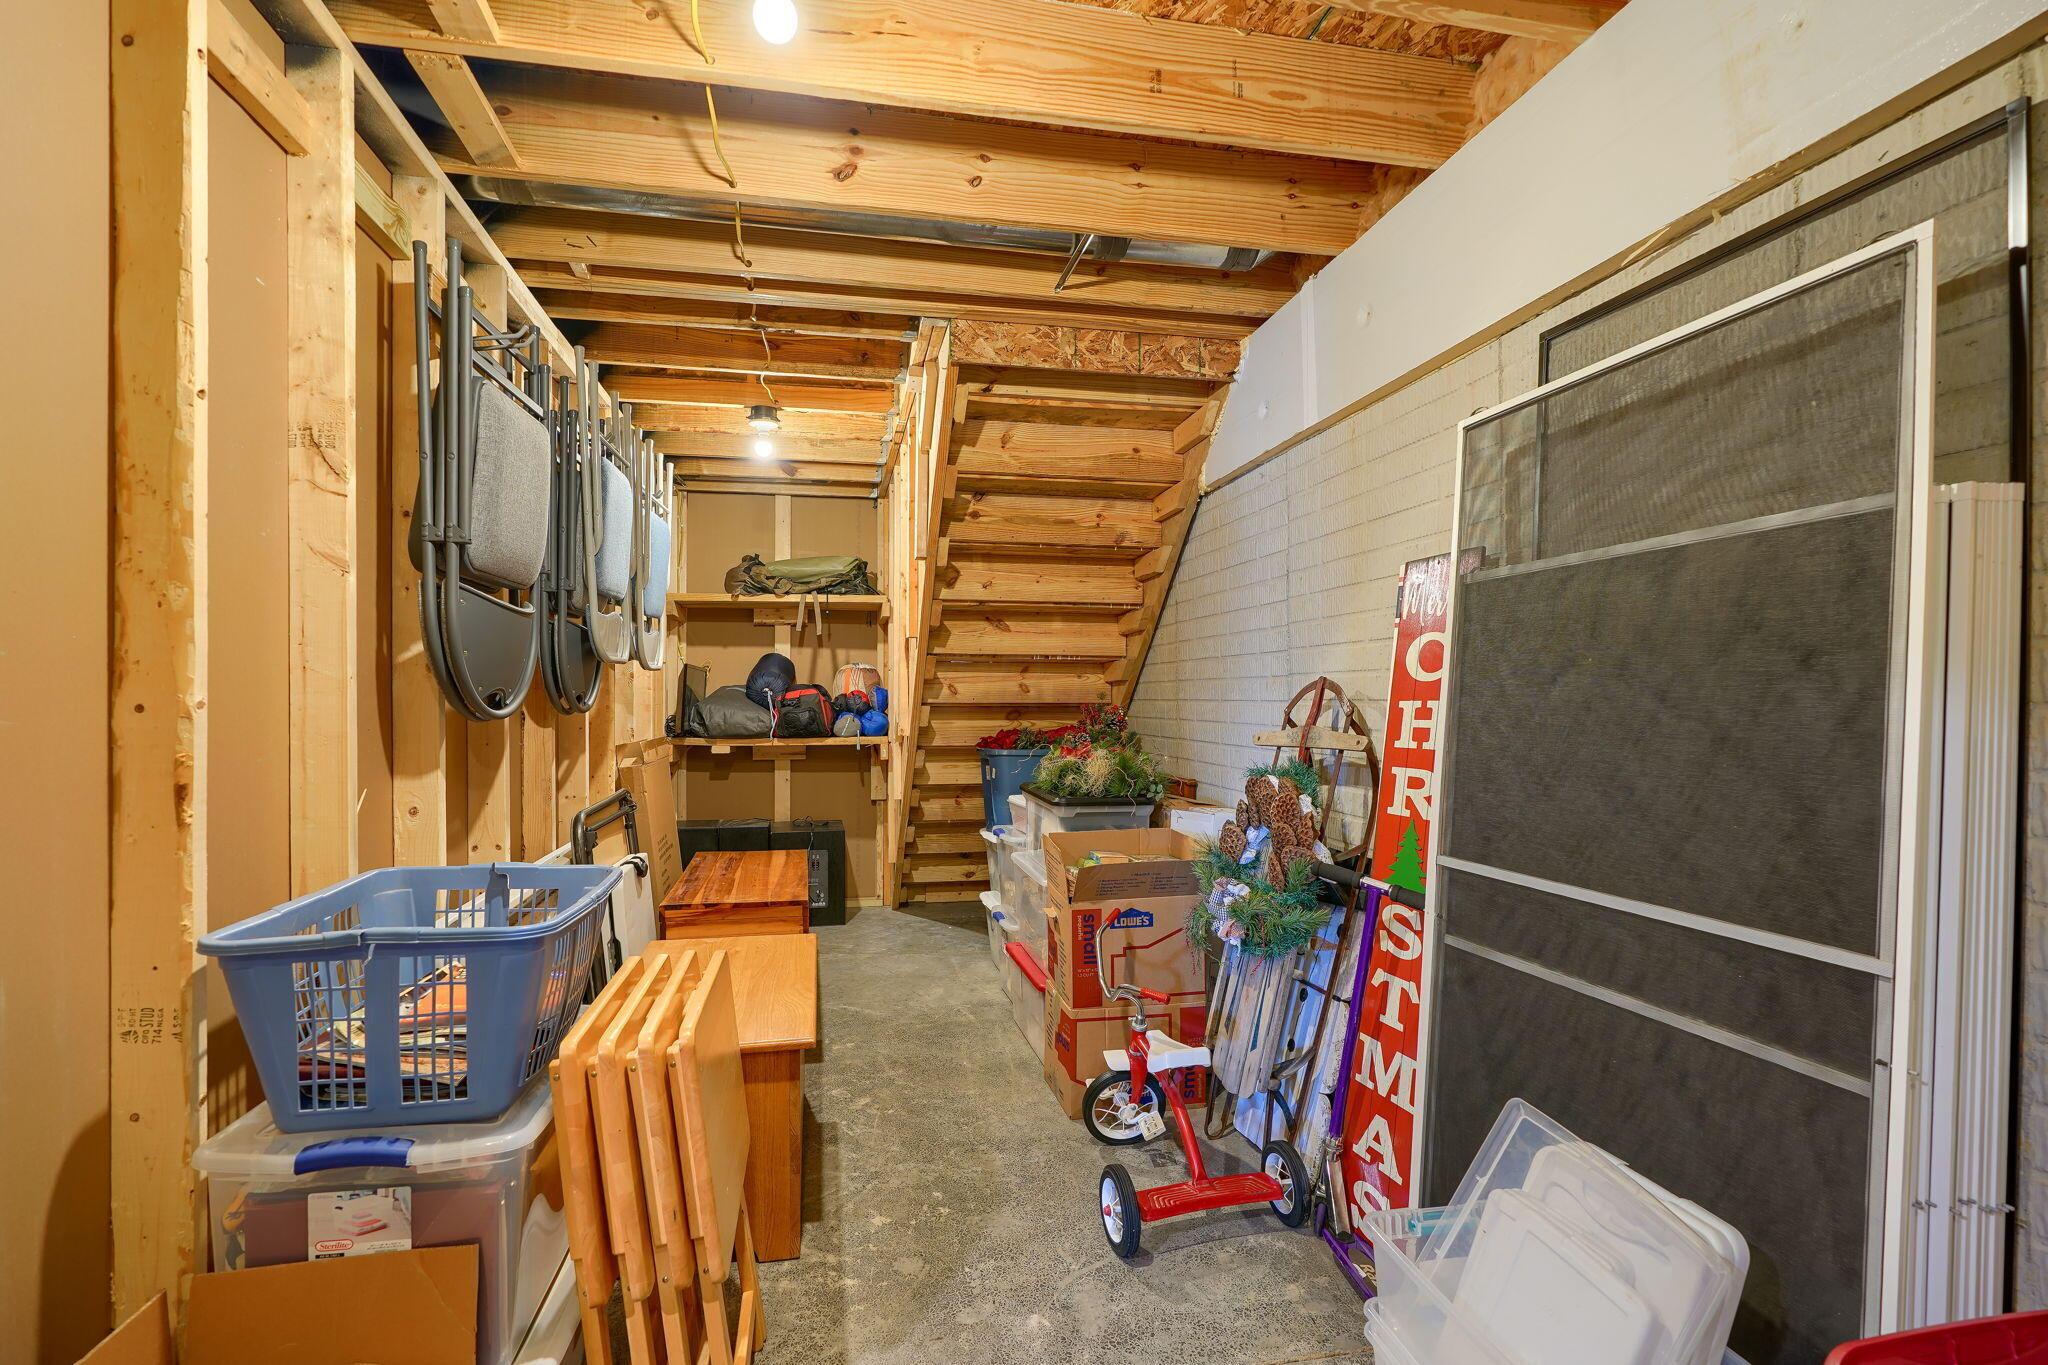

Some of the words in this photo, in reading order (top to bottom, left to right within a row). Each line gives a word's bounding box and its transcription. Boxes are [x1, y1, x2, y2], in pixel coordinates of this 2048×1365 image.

[1114, 915, 1150, 927] LOWE'S
[1083, 913, 1097, 965] small
[139, 1007, 155, 1028] STUD
[156, 1007, 164, 1028] NLGA
[152, 1029, 163, 1044] 714
[319, 1241, 348, 1250] Sterilite
